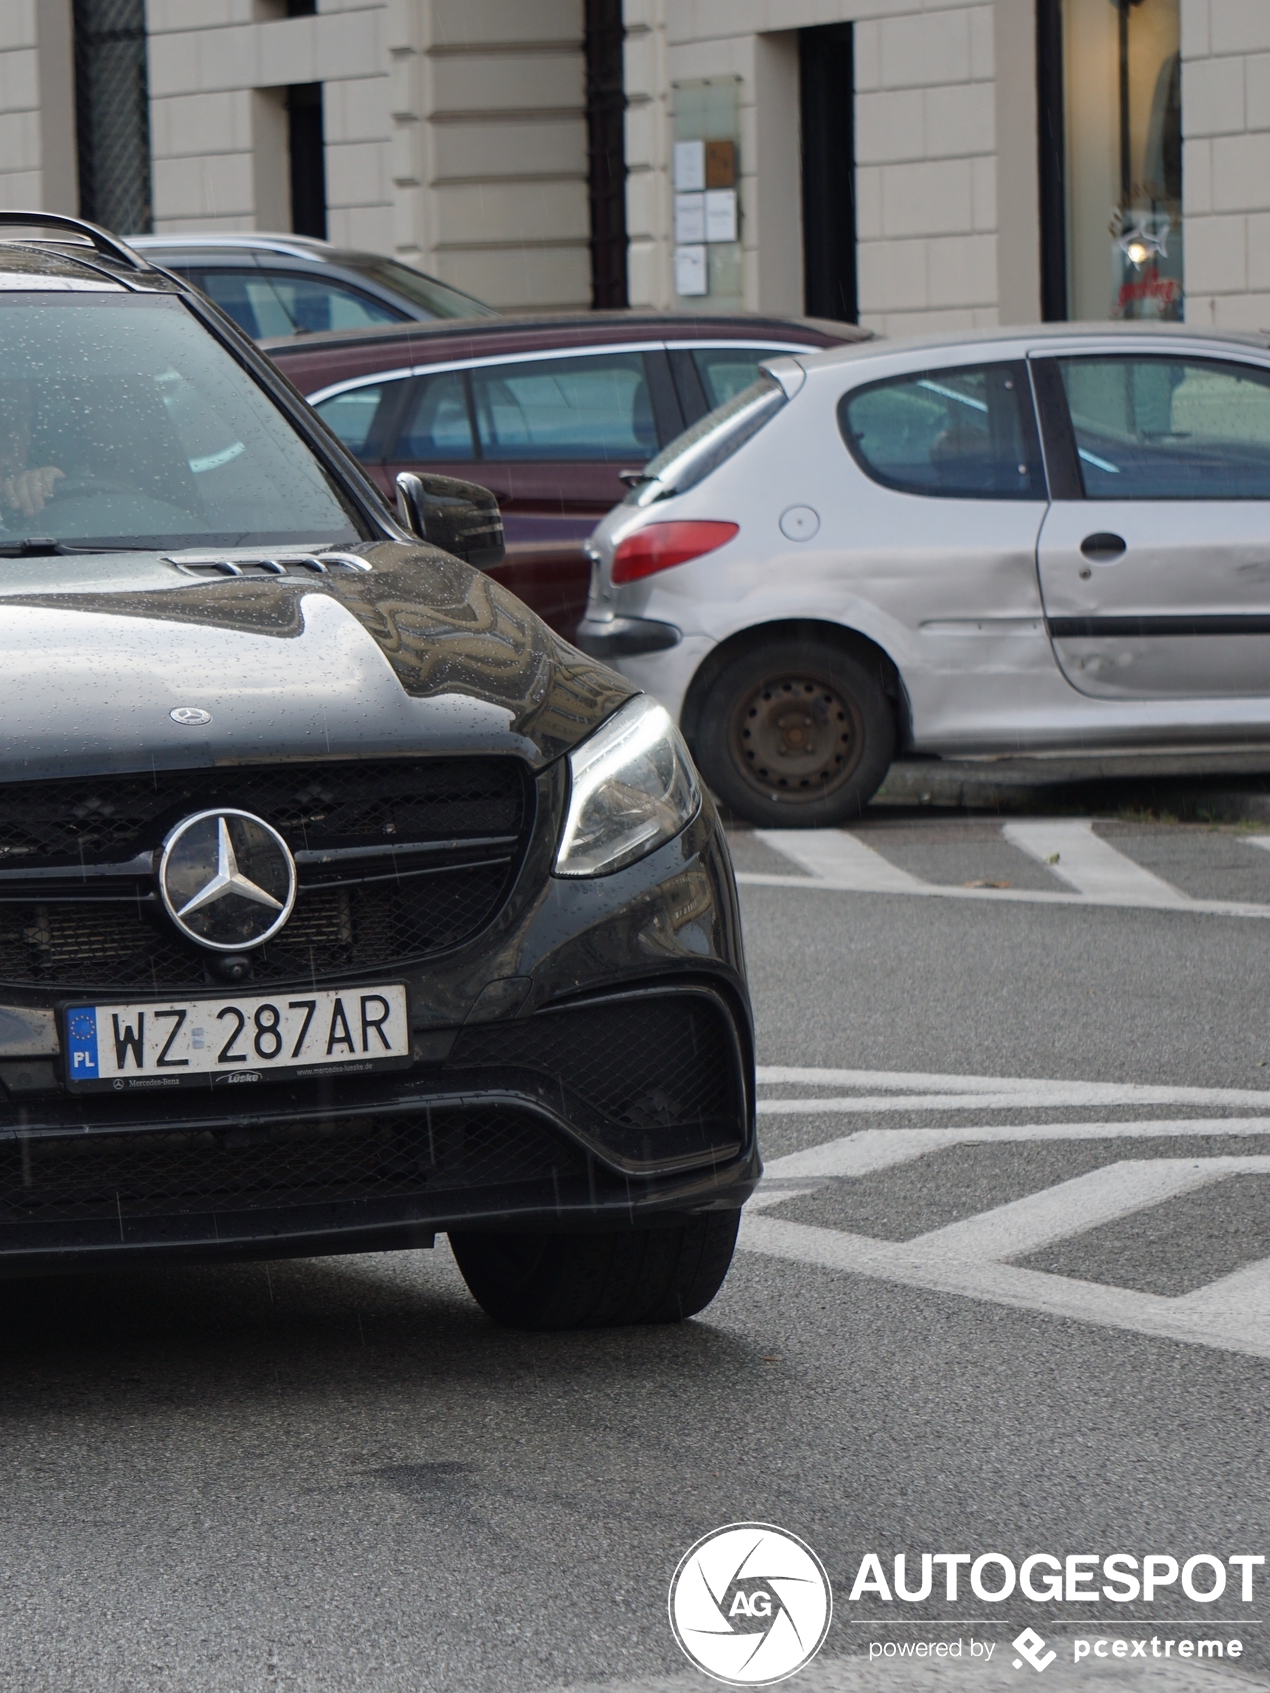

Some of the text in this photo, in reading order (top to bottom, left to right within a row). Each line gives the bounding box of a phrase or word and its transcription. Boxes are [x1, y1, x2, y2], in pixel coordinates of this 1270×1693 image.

[111, 993, 393, 1070] WZ 287AR
[73, 1051, 95, 1068] PL
[129, 1077, 181, 1088] Mercedes-Benz
[227, 1072, 259, 1084] Lüske
